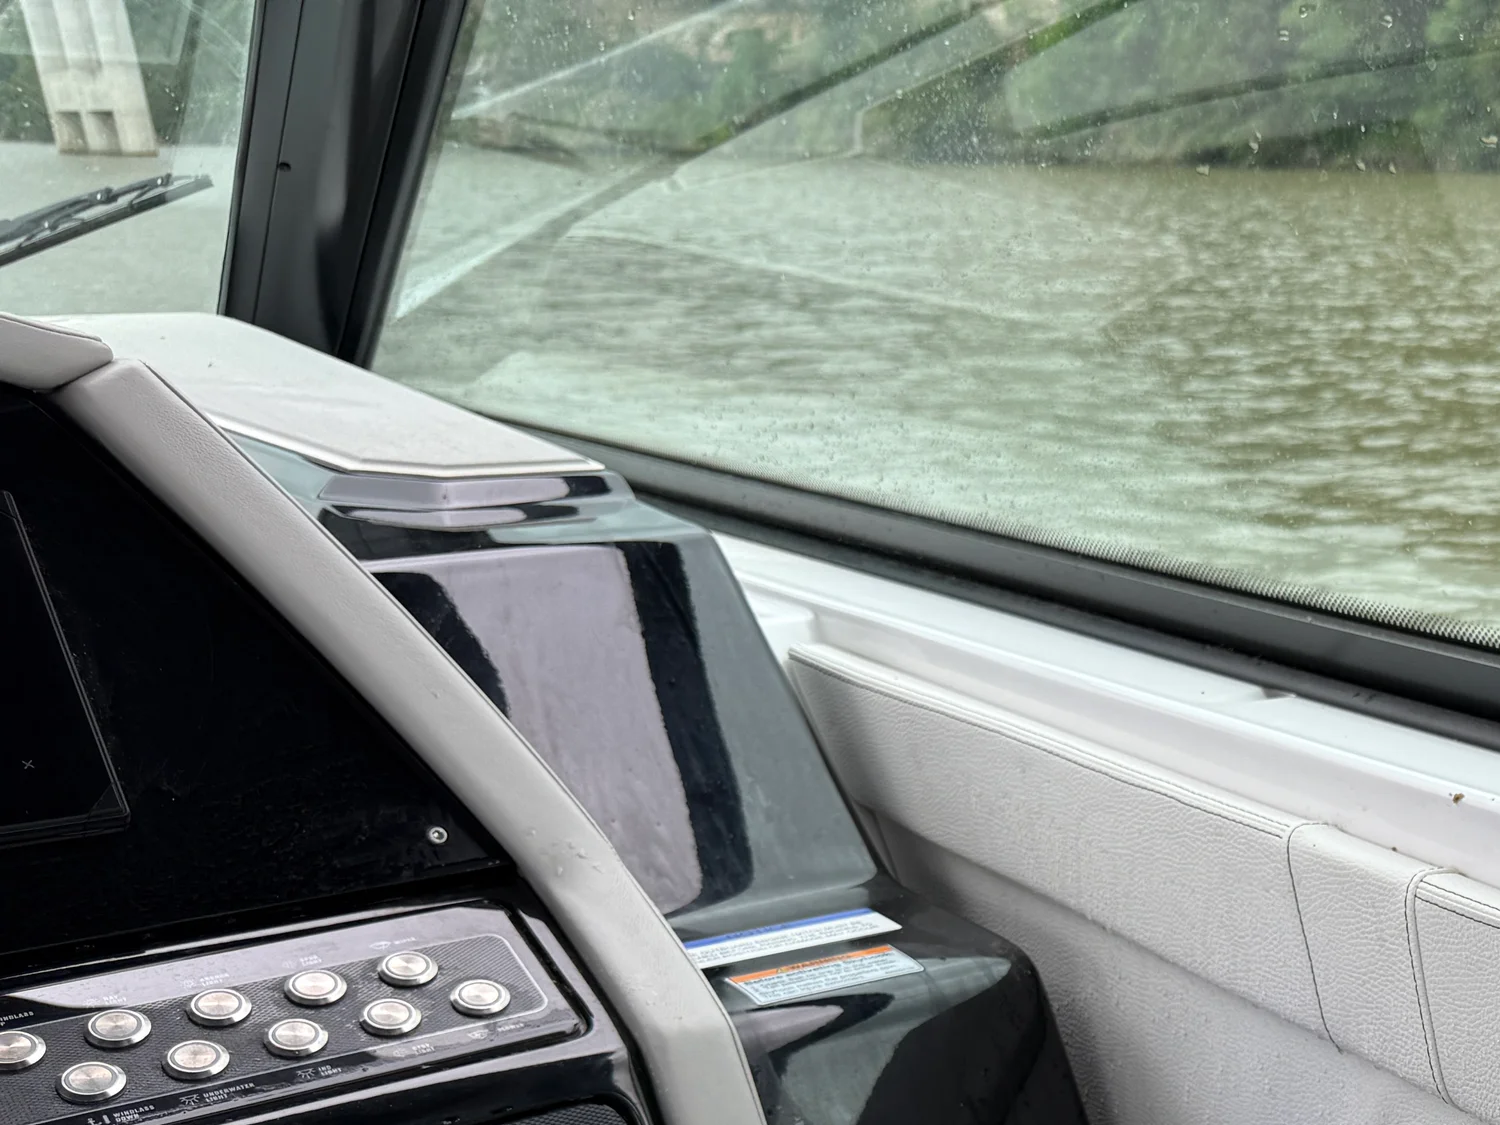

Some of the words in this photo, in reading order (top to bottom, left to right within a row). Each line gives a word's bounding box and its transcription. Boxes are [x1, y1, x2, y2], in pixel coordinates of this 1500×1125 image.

[0, 1011, 35, 1022] INDLASS
[203, 1082, 255, 1098] UNDERWATER
[112, 1104, 155, 1118] WINDLASS
